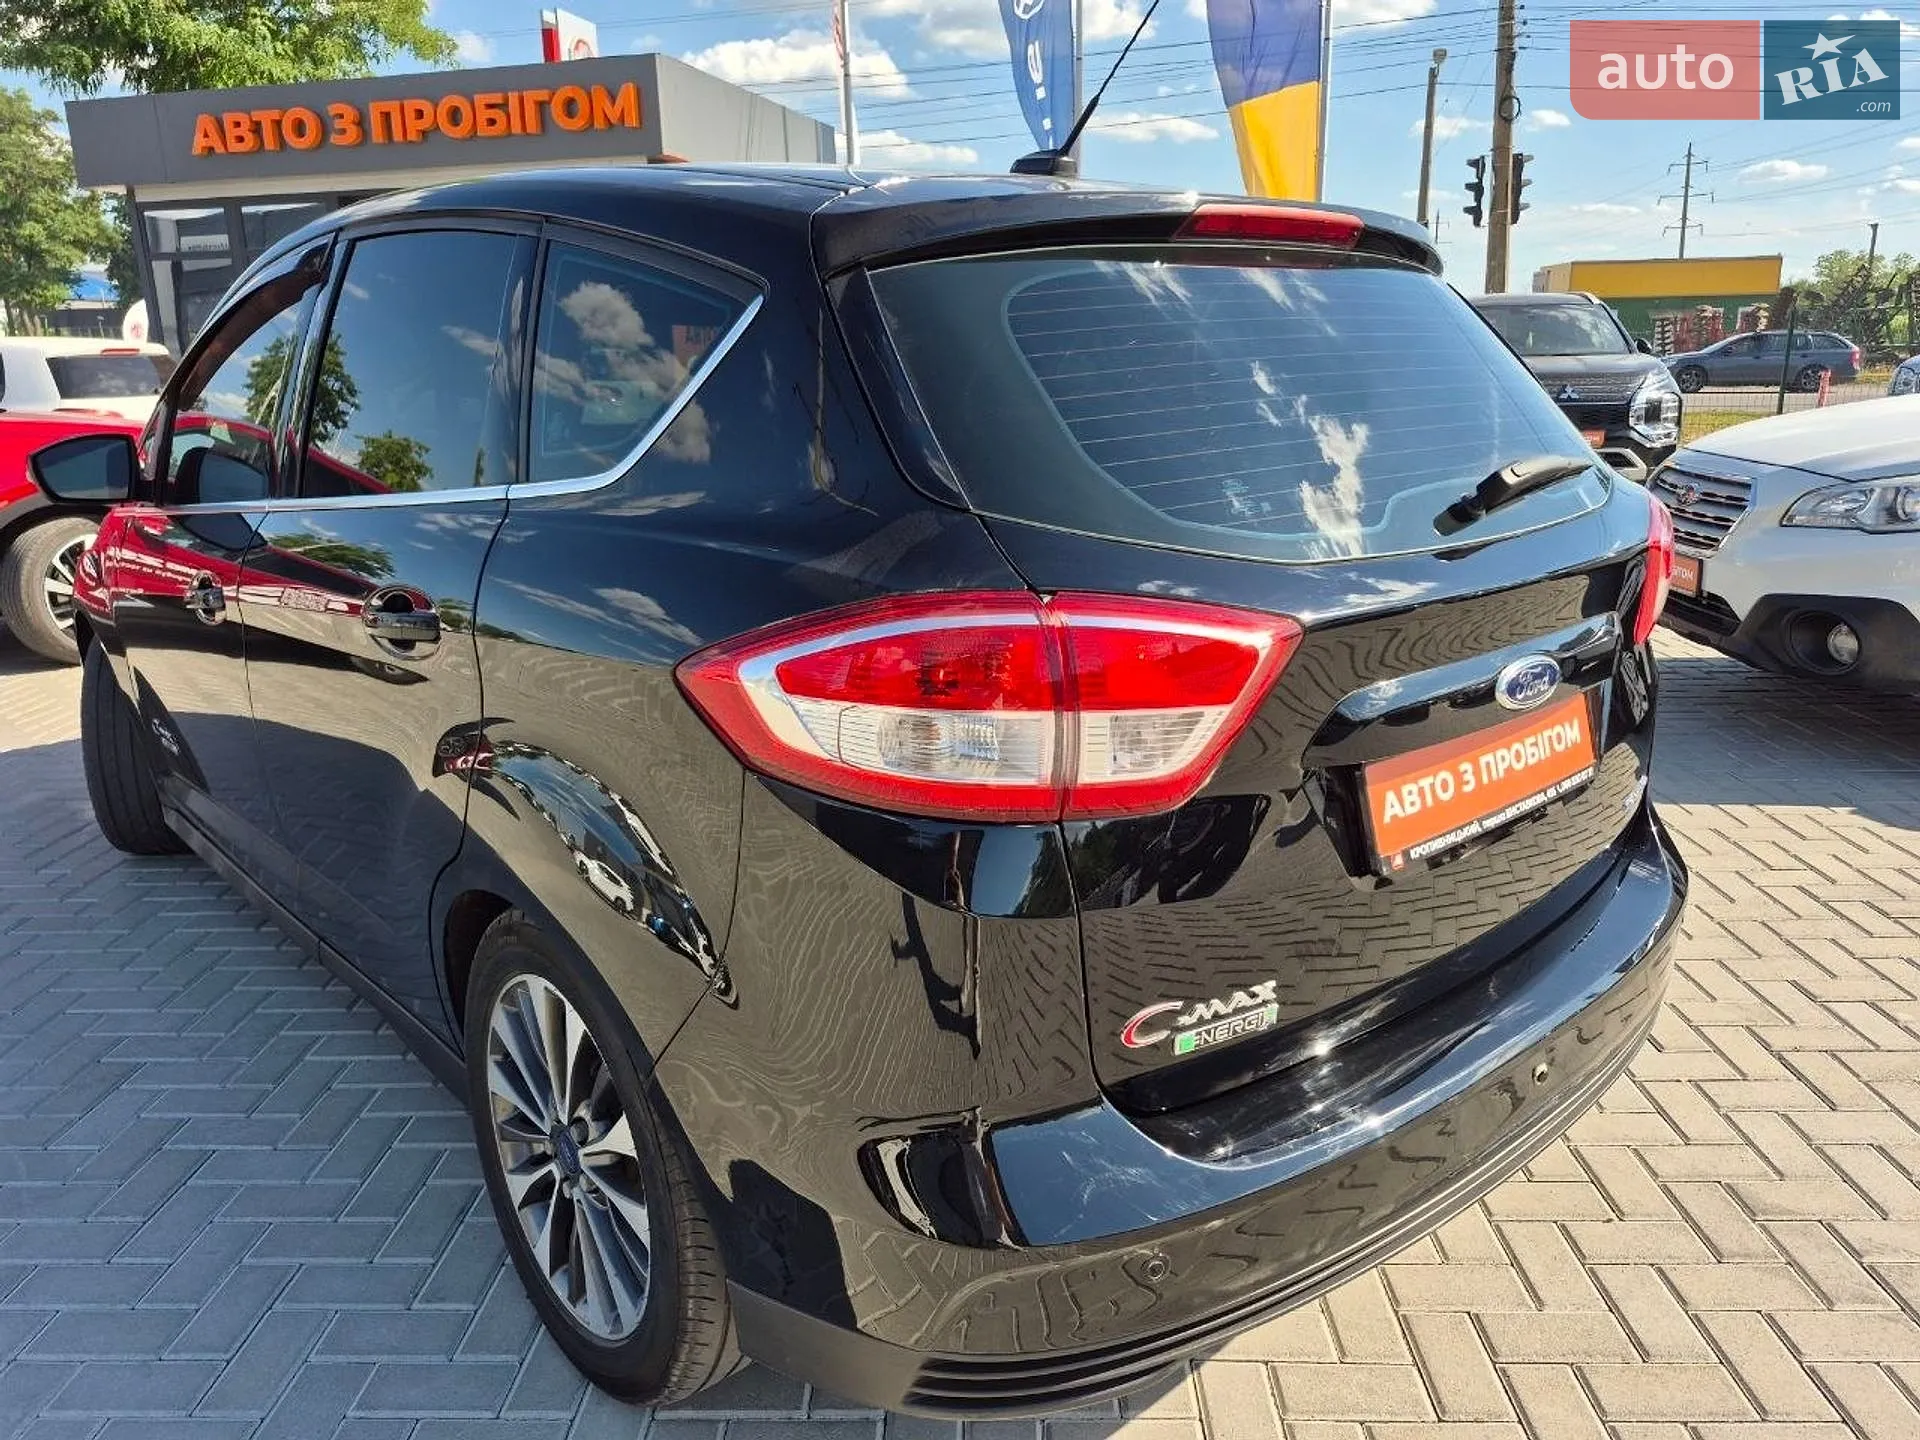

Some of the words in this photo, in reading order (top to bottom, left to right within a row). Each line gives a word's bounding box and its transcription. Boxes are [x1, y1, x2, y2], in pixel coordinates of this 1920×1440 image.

[192, 108, 323, 155] АВТО
[328, 103, 364, 147] З
[369, 82, 640, 143] ПРОБІГОМ
[1515, 666, 1552, 700] Ford
[1384, 770, 1455, 824] АВТО
[1459, 761, 1477, 794] З
[1480, 720, 1580, 784] ПРОБІГОМ
